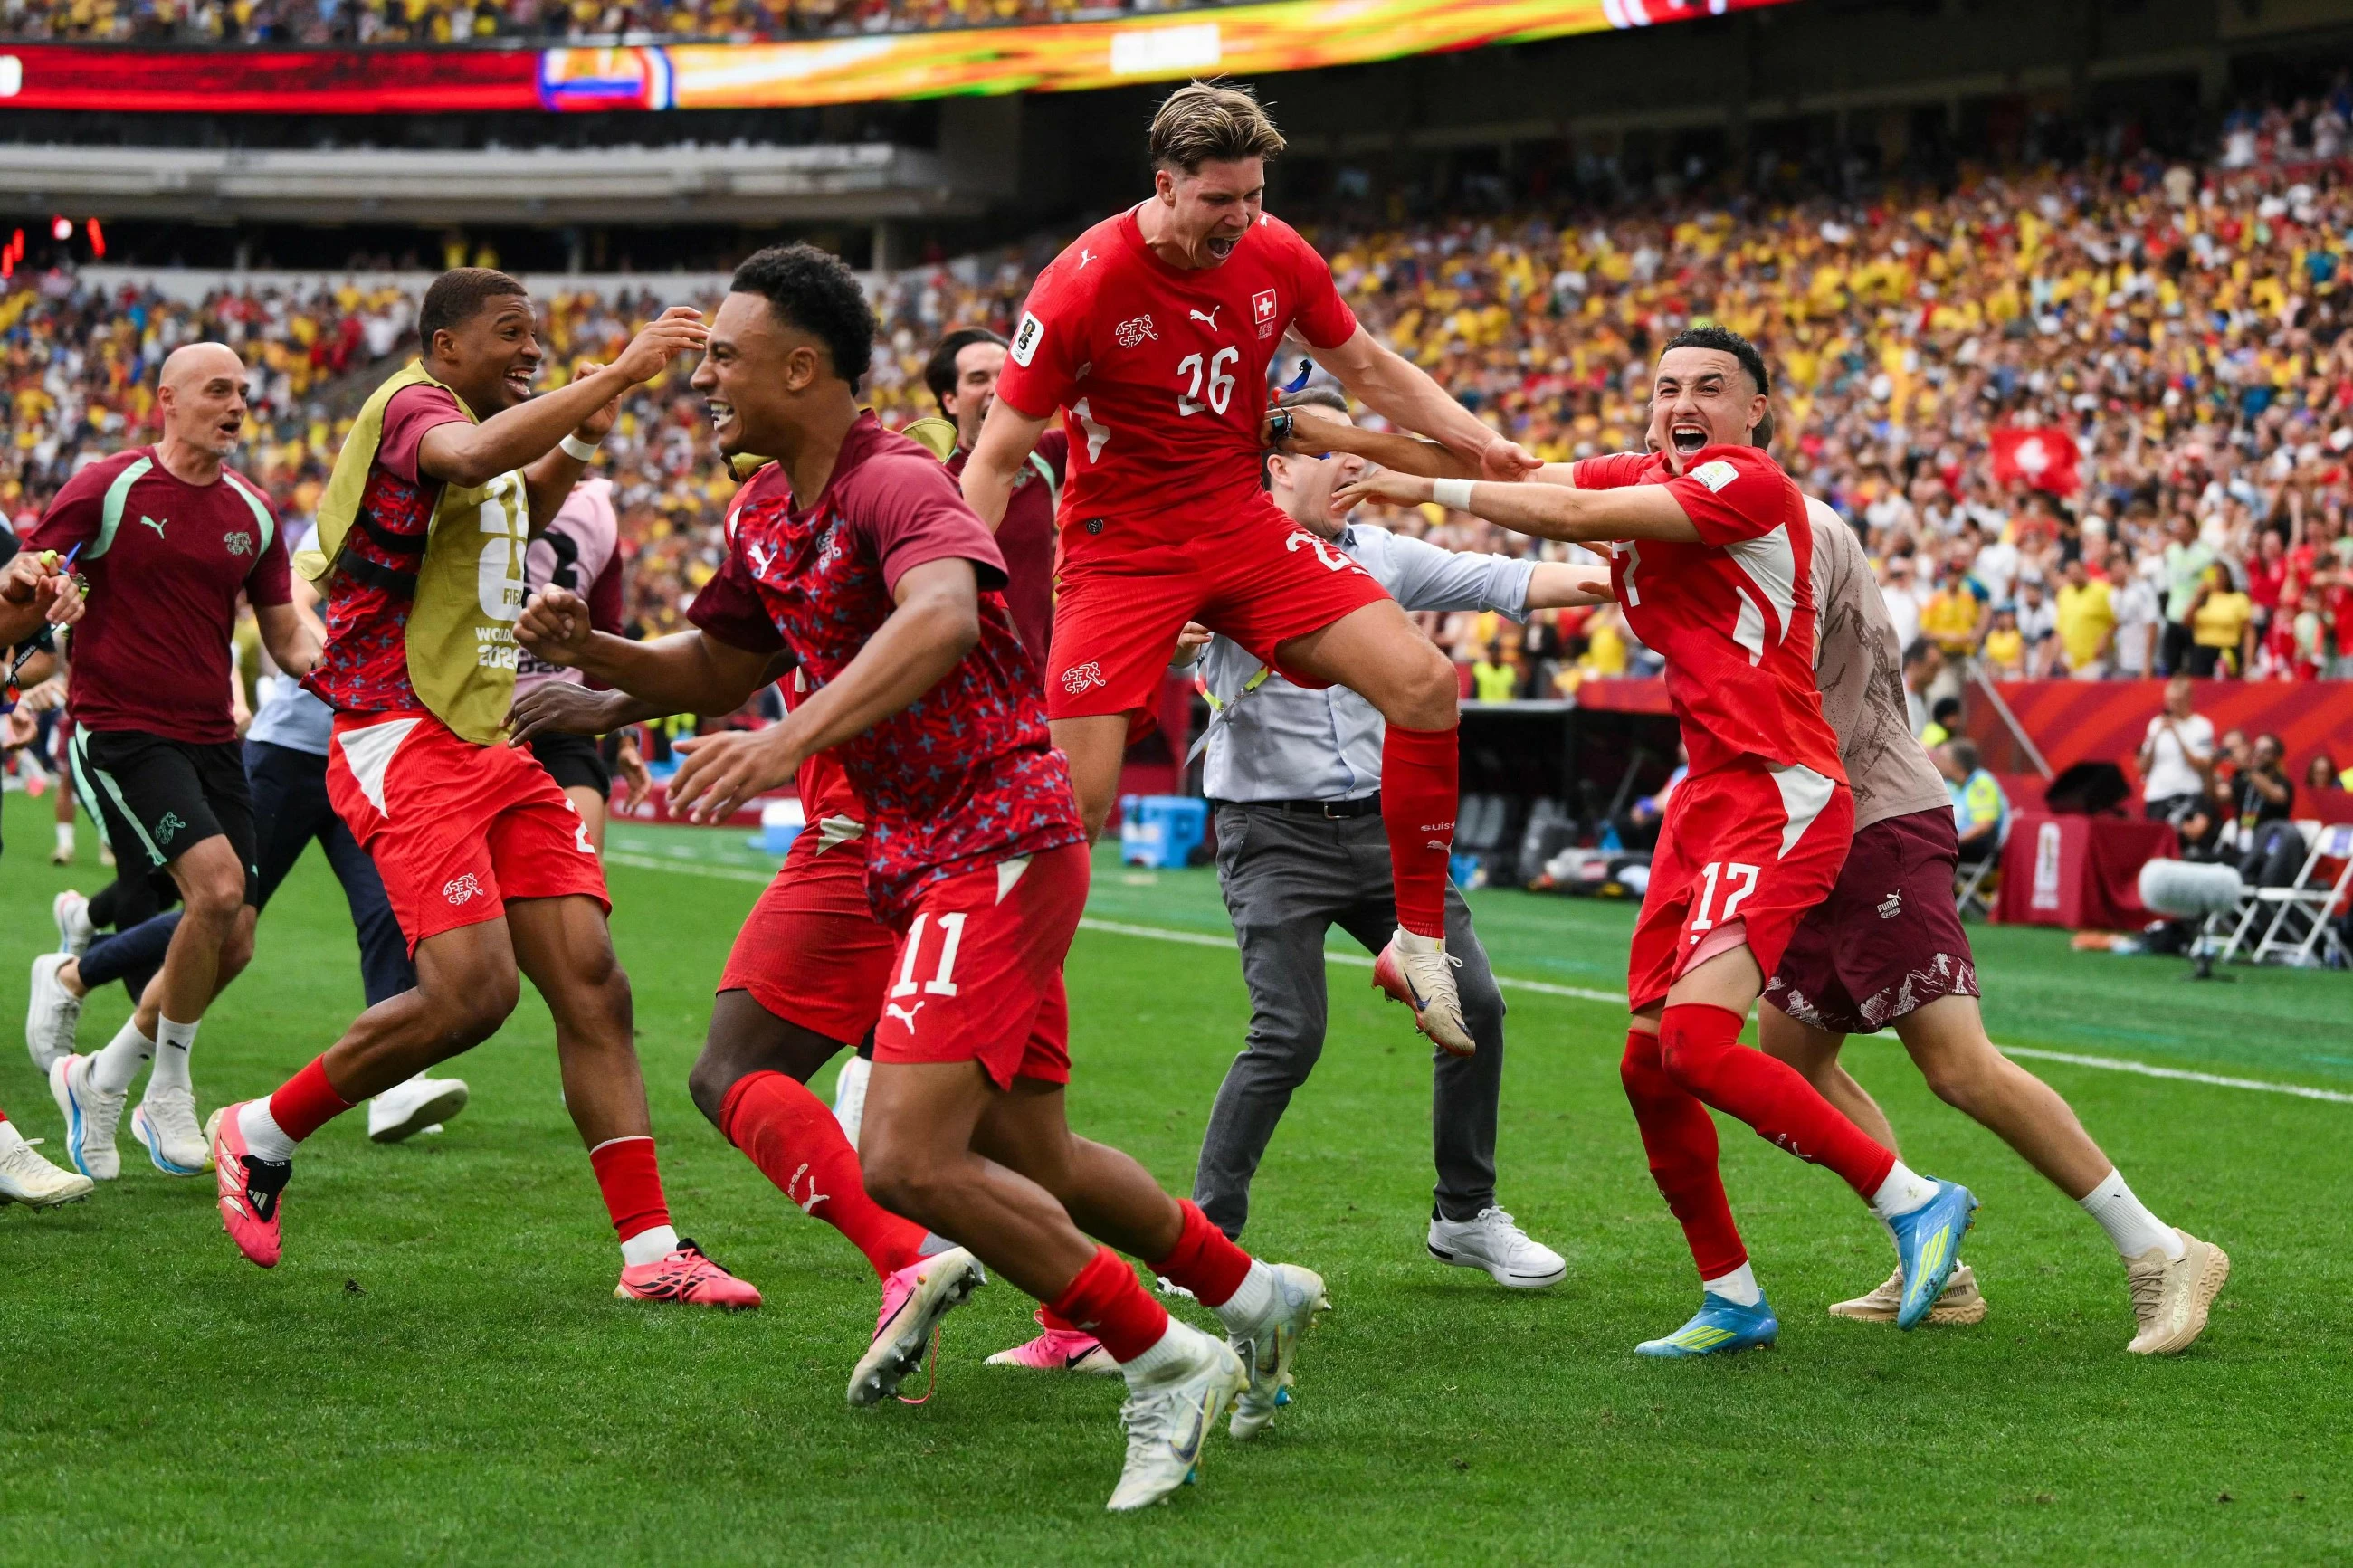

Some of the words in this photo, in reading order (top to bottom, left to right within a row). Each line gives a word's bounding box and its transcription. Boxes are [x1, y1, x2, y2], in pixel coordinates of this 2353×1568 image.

[1177, 345, 1239, 417] 26
[1285, 530, 1353, 572] 2
[1612, 539, 1641, 609] 7
[1691, 862, 1762, 931] 17
[1876, 898, 1900, 913] PUMA
[890, 911, 968, 999] 11
